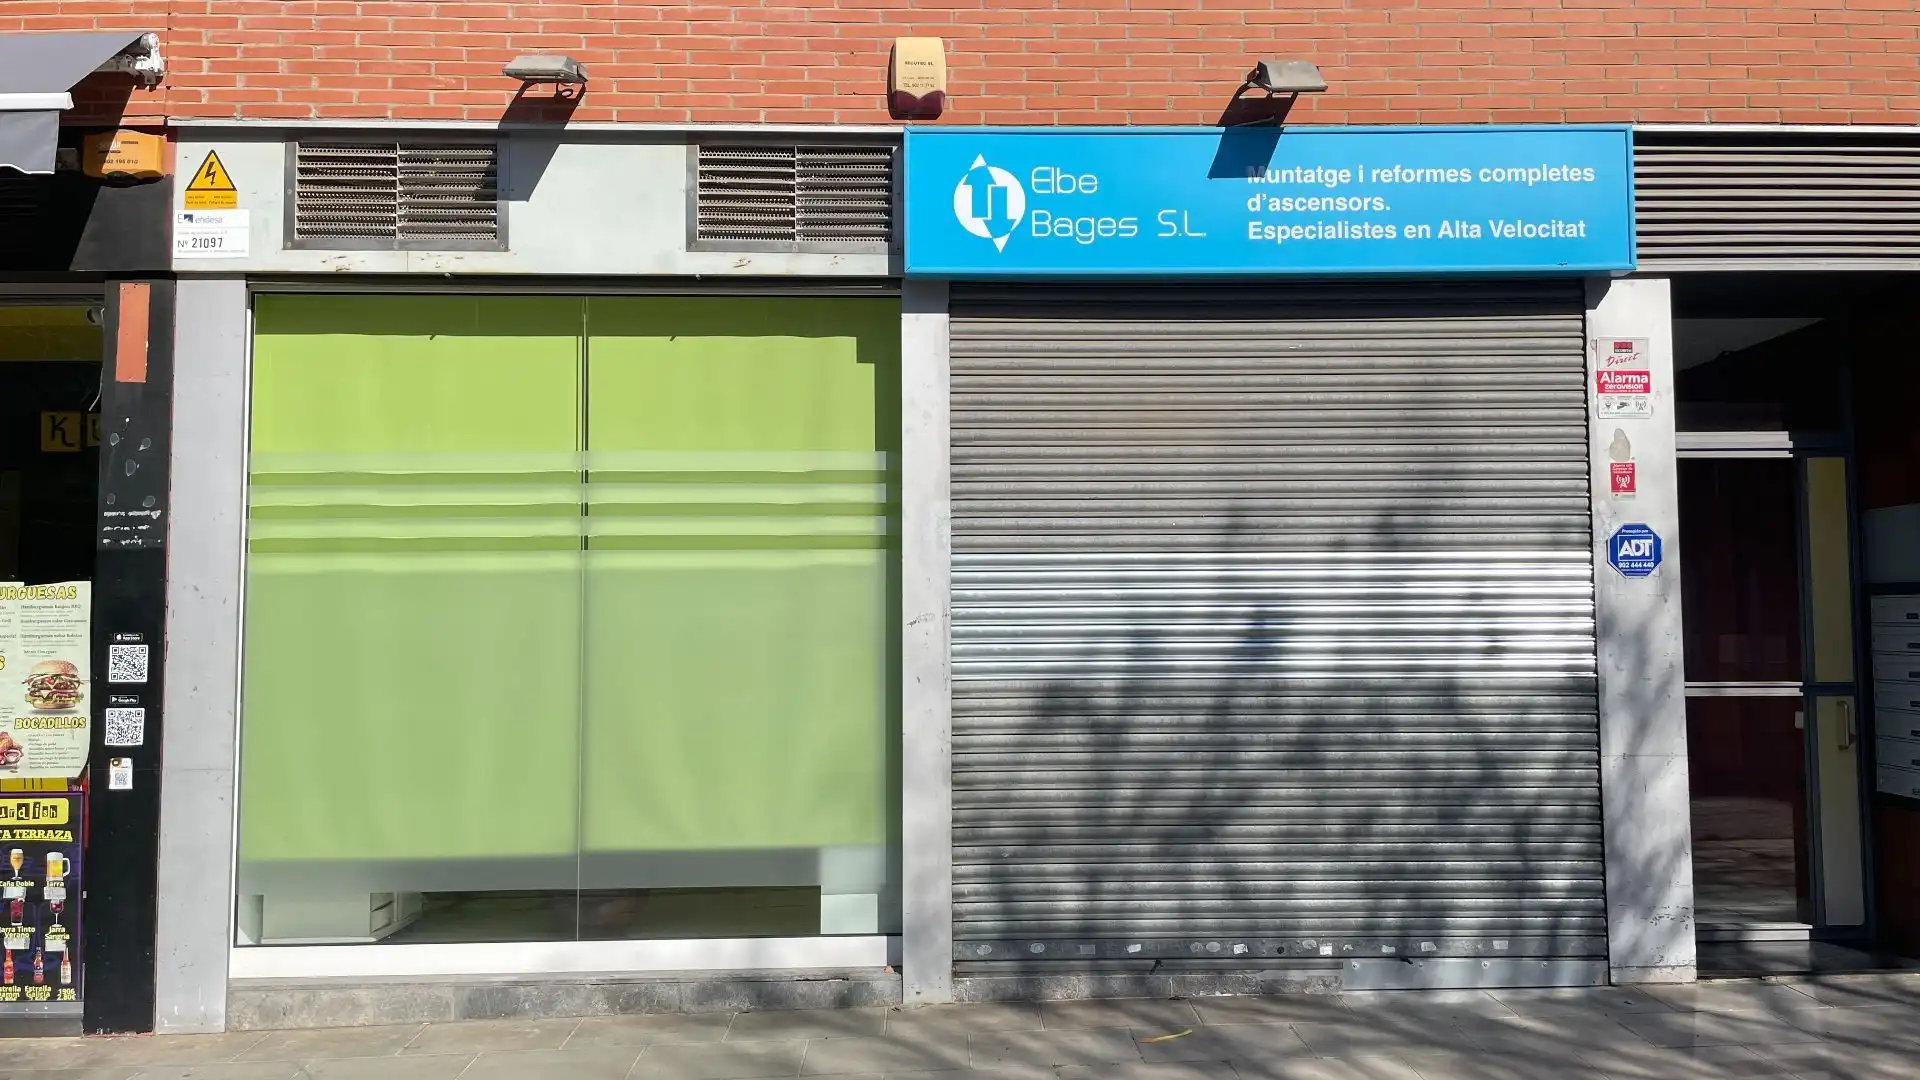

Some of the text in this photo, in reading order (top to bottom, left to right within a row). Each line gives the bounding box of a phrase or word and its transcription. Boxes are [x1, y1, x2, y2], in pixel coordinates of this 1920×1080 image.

[1031, 166, 1099, 194] Elbe
[1246, 163, 1596, 188] Muntatge i reformes completes
[1031, 209, 1139, 244] Bages
[1248, 218, 1587, 244] Especialistes en Alta Velocitat
[192, 237, 223, 249] 21097
[1600, 371, 1649, 384] Alarma
[1618, 539, 1653, 557] ADT
[14, 716, 87, 730] BOCADILLOS
[13, 829, 72, 841] TERRAZA
